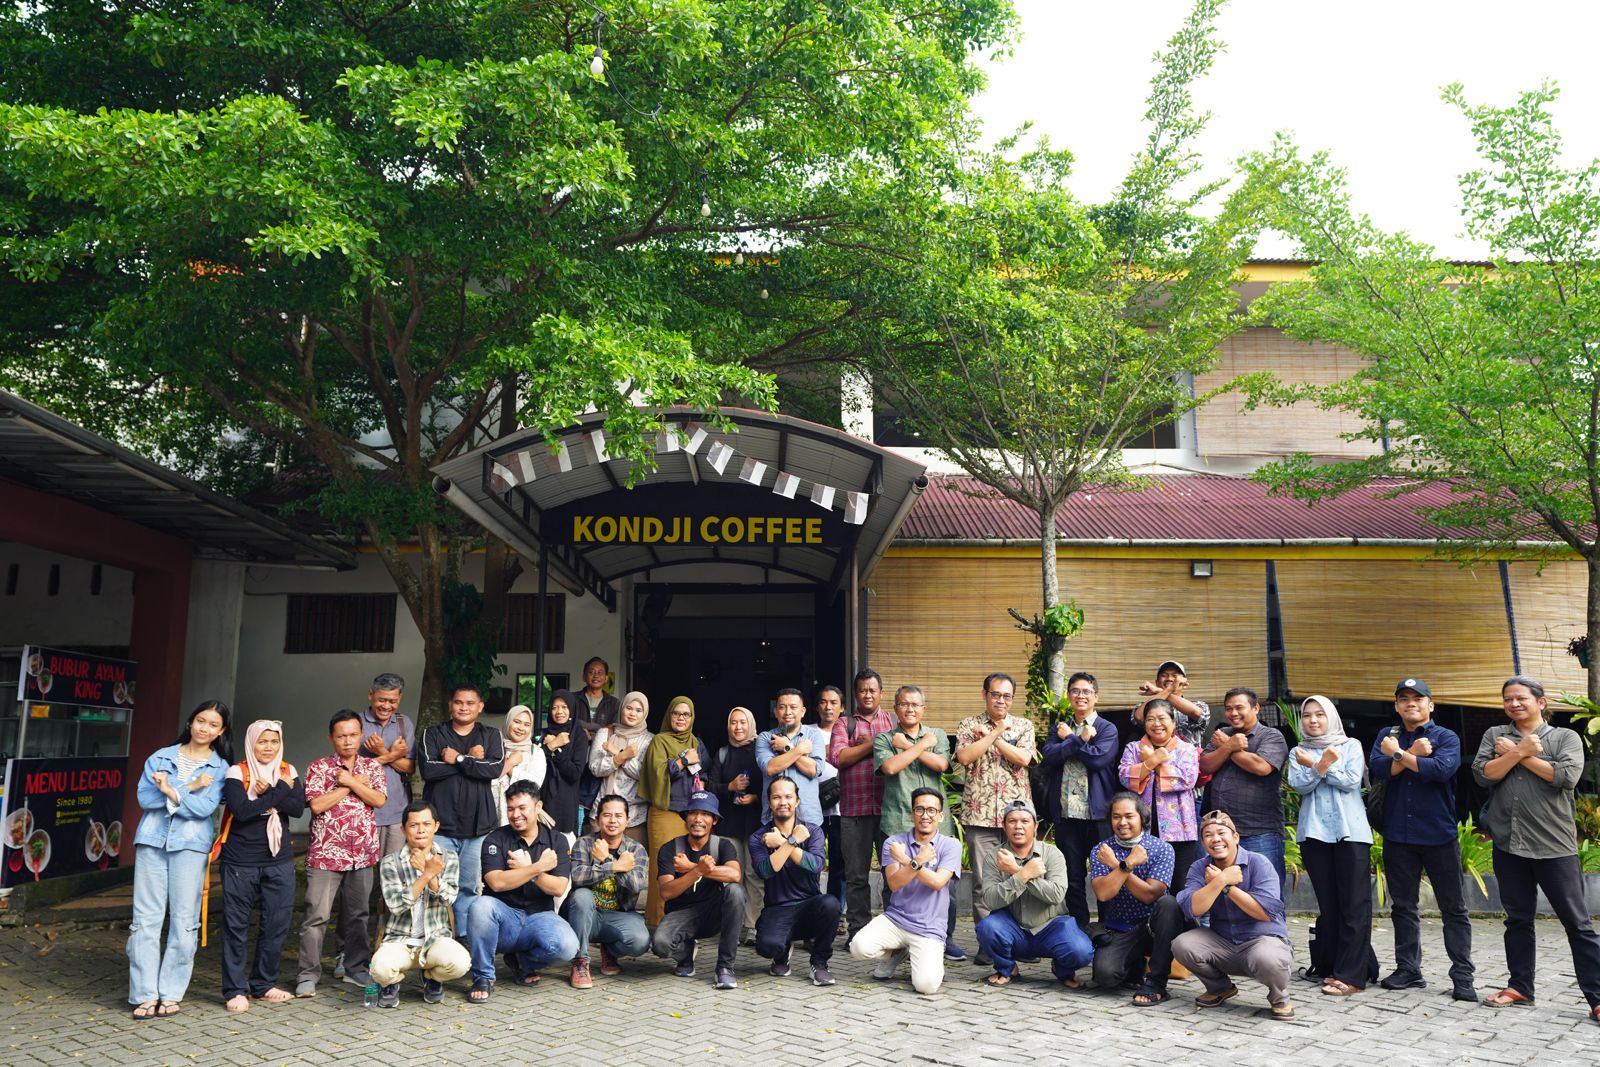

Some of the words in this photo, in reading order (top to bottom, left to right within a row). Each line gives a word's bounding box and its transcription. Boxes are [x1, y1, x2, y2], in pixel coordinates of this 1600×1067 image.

[574, 516, 691, 543] KONDJI
[700, 516, 822, 543] COFFEE
[50, 656, 89, 678] BUBUR
[95, 664, 126, 682] AYAM
[74, 681, 102, 699] KING
[25, 772, 67, 794] MENU
[70, 769, 121, 791] LEGEND
[56, 798, 76, 807] Since
